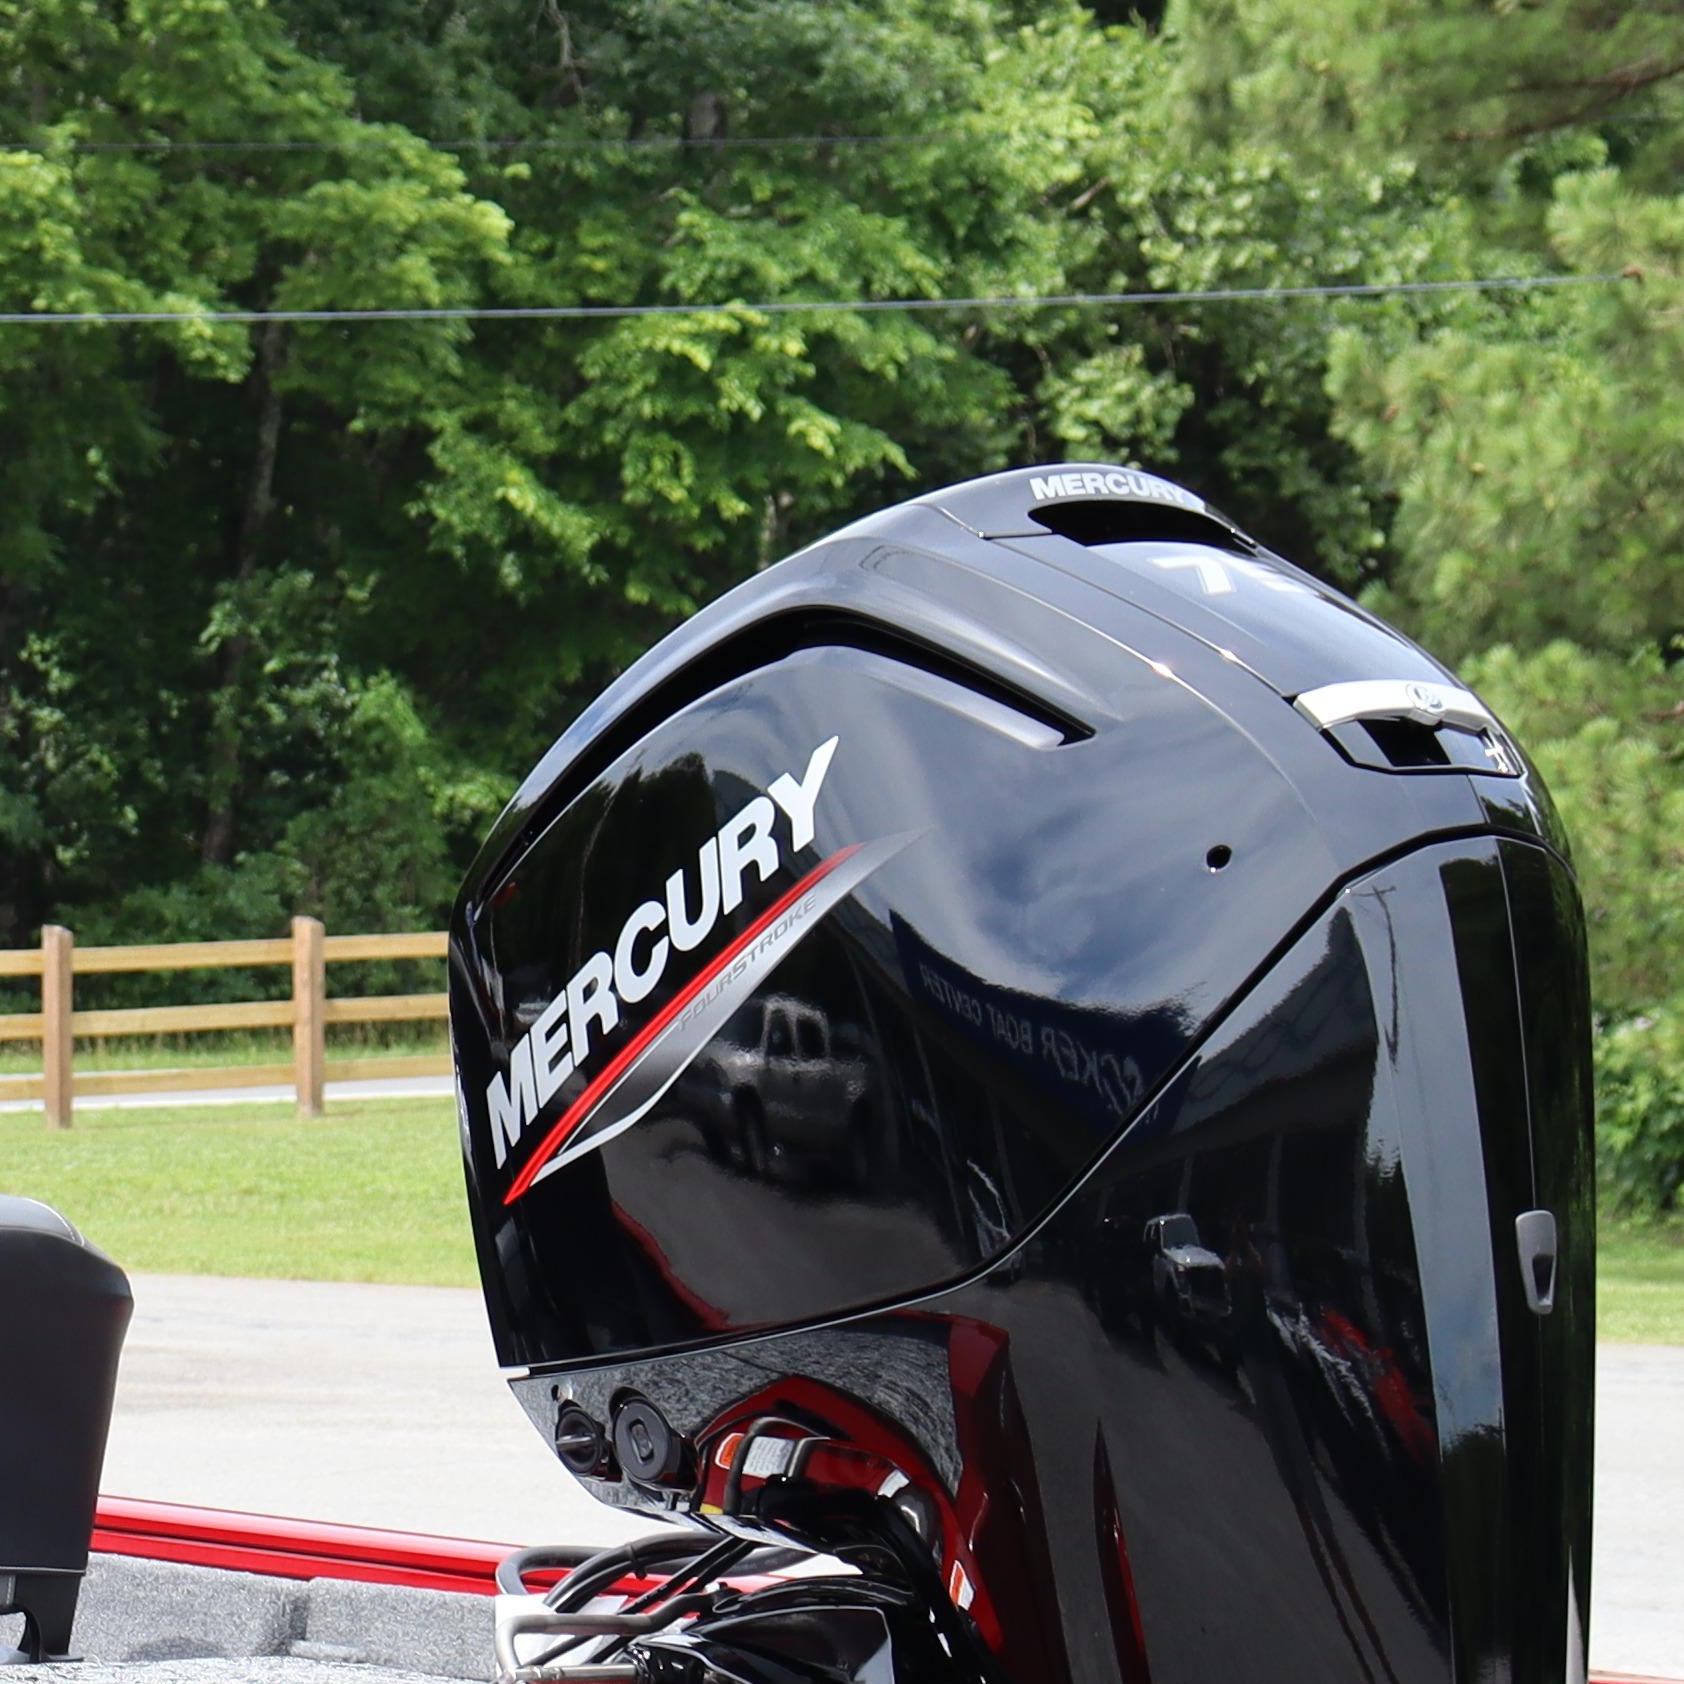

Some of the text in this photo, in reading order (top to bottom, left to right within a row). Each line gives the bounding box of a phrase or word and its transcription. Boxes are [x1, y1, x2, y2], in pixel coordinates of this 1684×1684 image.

[1030, 472, 1186, 503] MERCURY
[487, 735, 840, 1170] MERCURY
[675, 893, 818, 1033] FOURSTROKE
